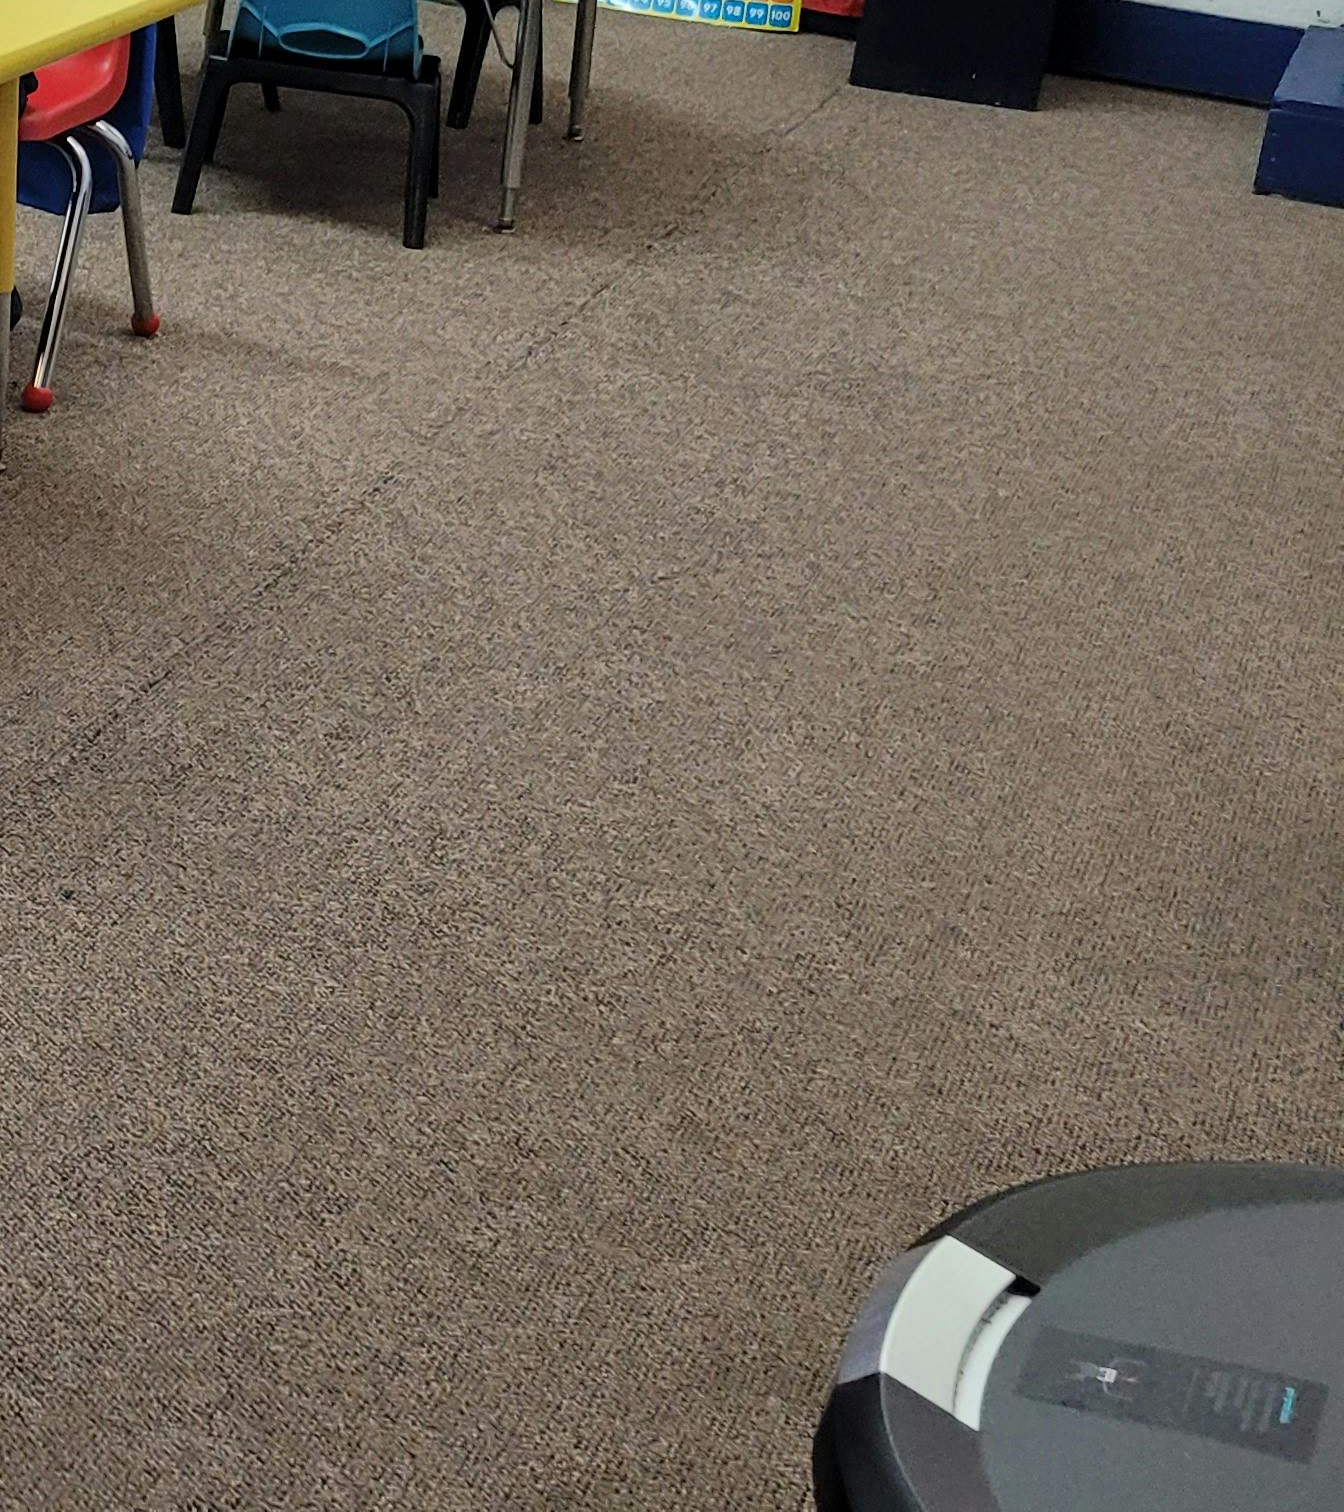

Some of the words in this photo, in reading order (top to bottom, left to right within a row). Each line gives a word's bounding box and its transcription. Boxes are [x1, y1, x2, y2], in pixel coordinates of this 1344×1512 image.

[703, 2, 718, 13] 97
[726, 4, 741, 17] 98
[749, 7, 764, 19] 99
[770, 9, 791, 22] 100
